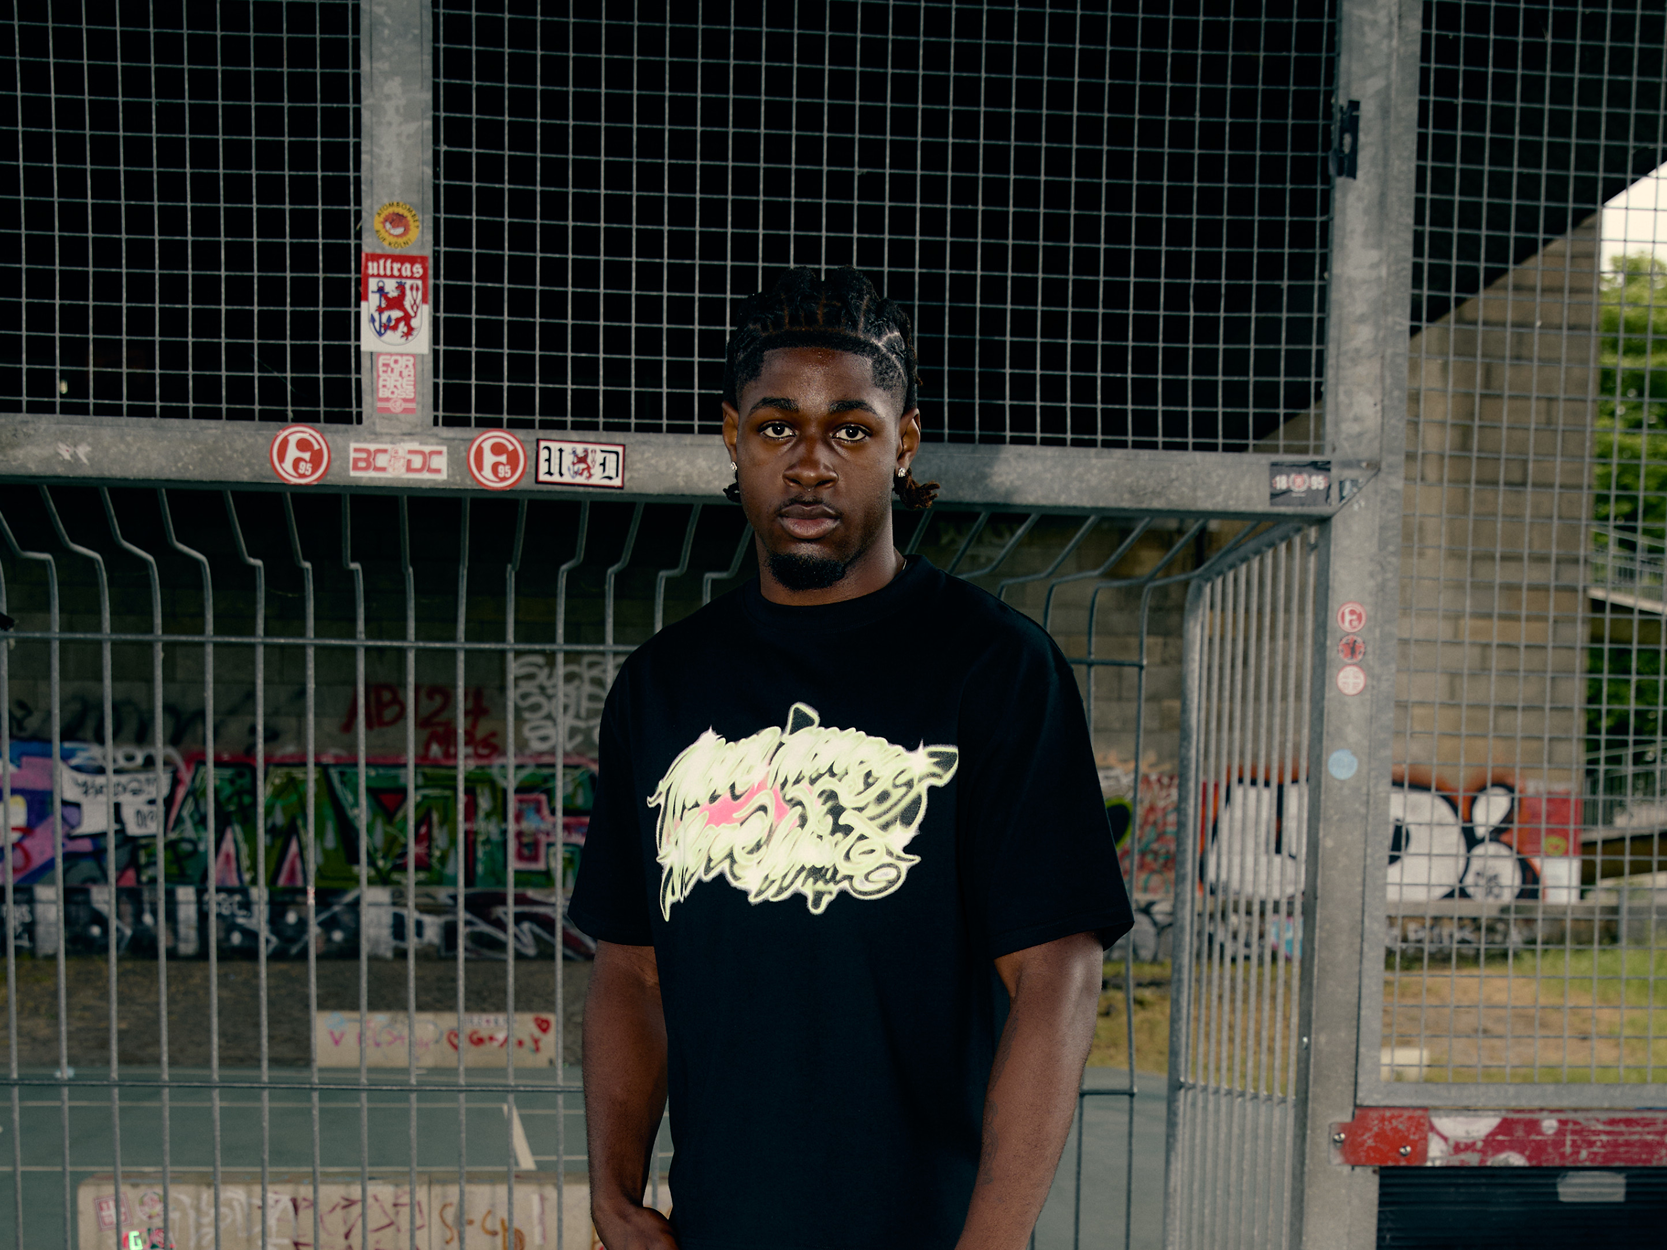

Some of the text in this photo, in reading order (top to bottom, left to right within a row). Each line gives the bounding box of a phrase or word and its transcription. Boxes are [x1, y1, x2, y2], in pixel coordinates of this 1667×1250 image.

[367, 258, 423, 278] ultras
[379, 355, 414, 368] FOR
[379, 377, 414, 390] ARE
[379, 389, 415, 398] BOSS
